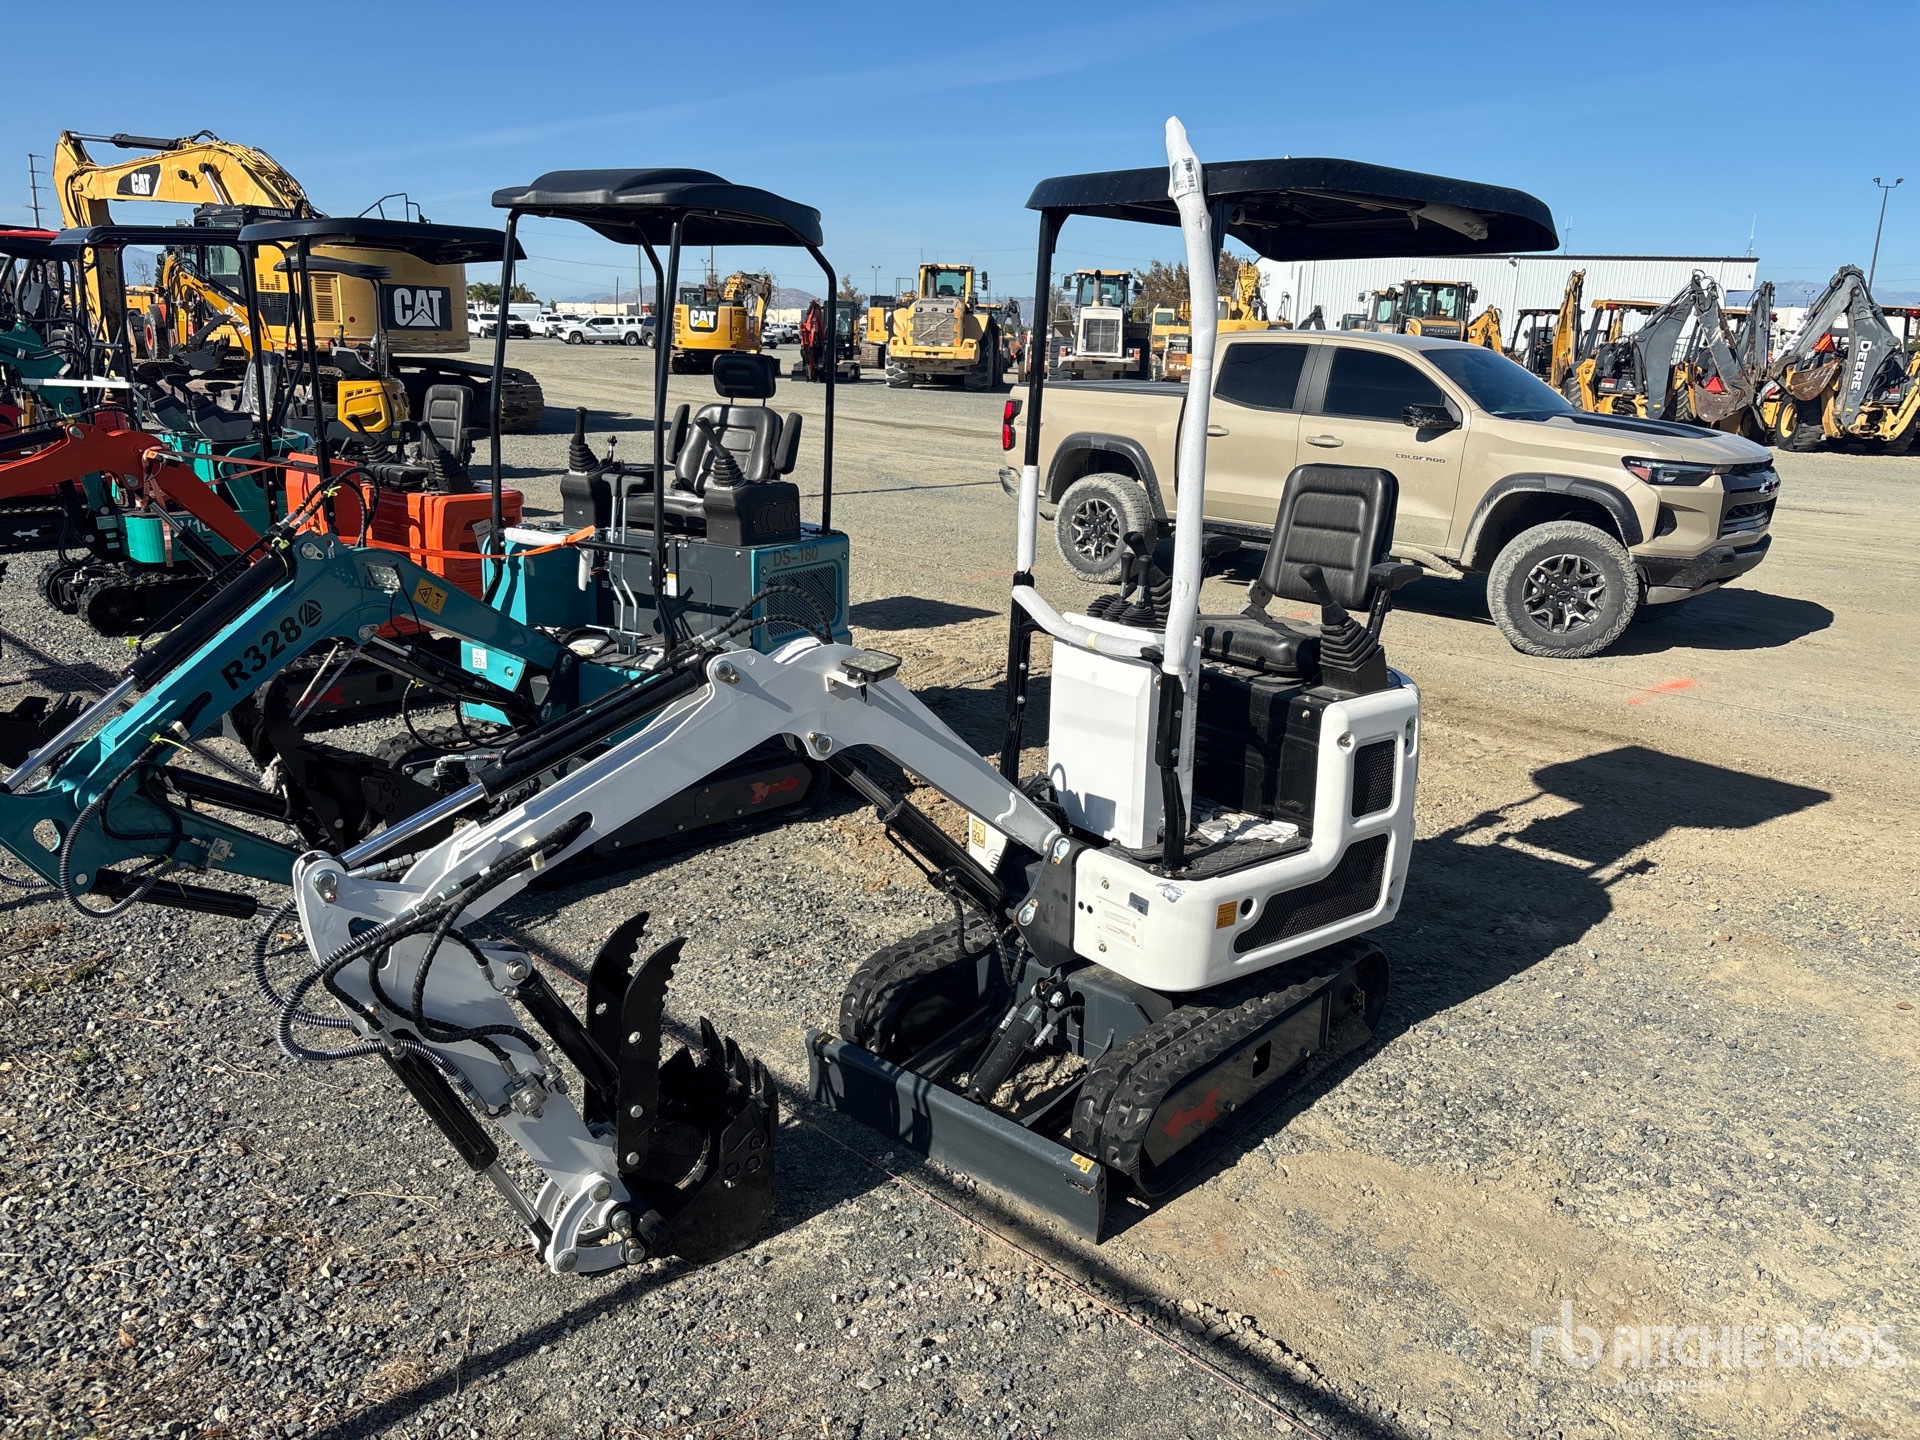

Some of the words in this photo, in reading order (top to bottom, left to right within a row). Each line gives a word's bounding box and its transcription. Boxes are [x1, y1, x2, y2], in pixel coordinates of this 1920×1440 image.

[131, 172, 151, 195] CAT
[393, 287, 443, 327] CAT
[690, 309, 717, 328] CAT
[1850, 340, 1873, 391] DEERE
[1395, 453, 1446, 464] COLORADO
[772, 545, 819, 567] DS-180
[220, 616, 303, 692] R328
